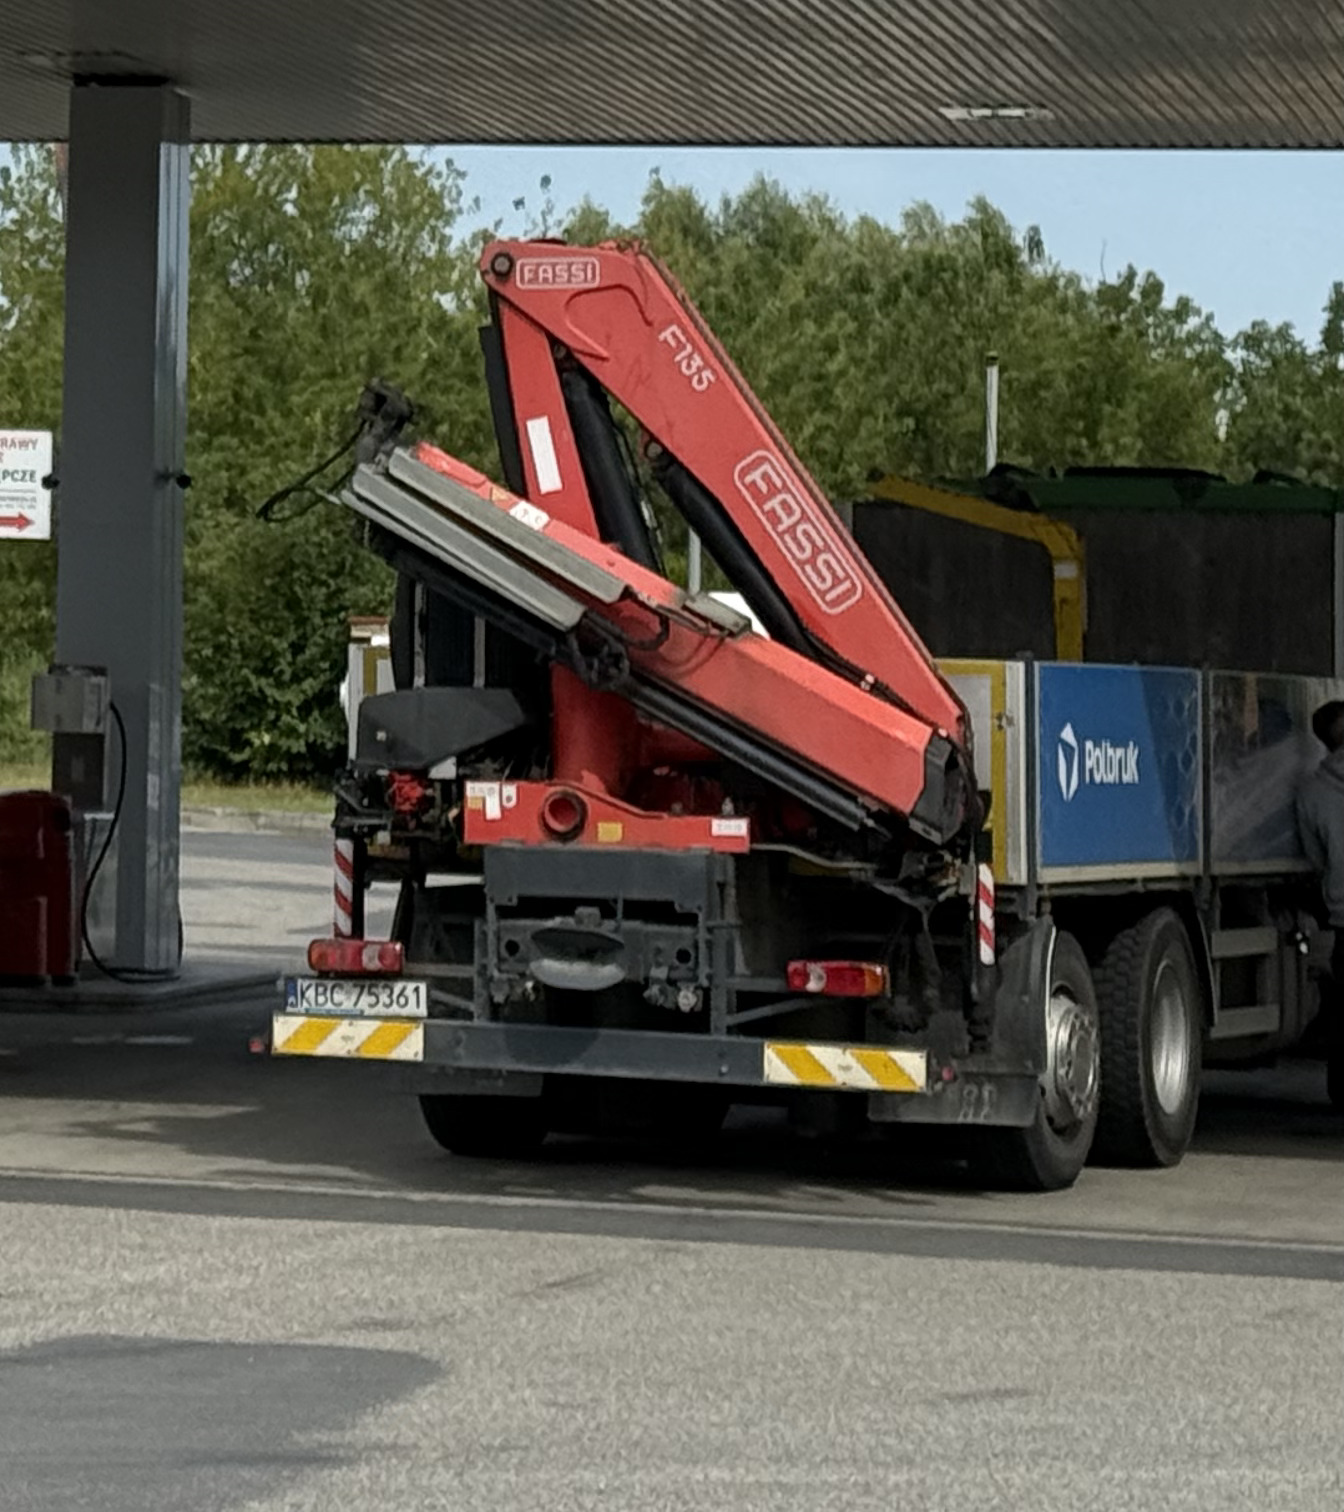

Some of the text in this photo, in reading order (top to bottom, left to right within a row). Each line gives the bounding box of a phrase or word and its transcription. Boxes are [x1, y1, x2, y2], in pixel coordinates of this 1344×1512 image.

[523, 263, 593, 283] FASSI
[658, 324, 716, 392] F135
[743, 462, 852, 602] FASSI
[1085, 739, 1140, 784] Polbruk
[300, 982, 421, 1010] KBC 75361
